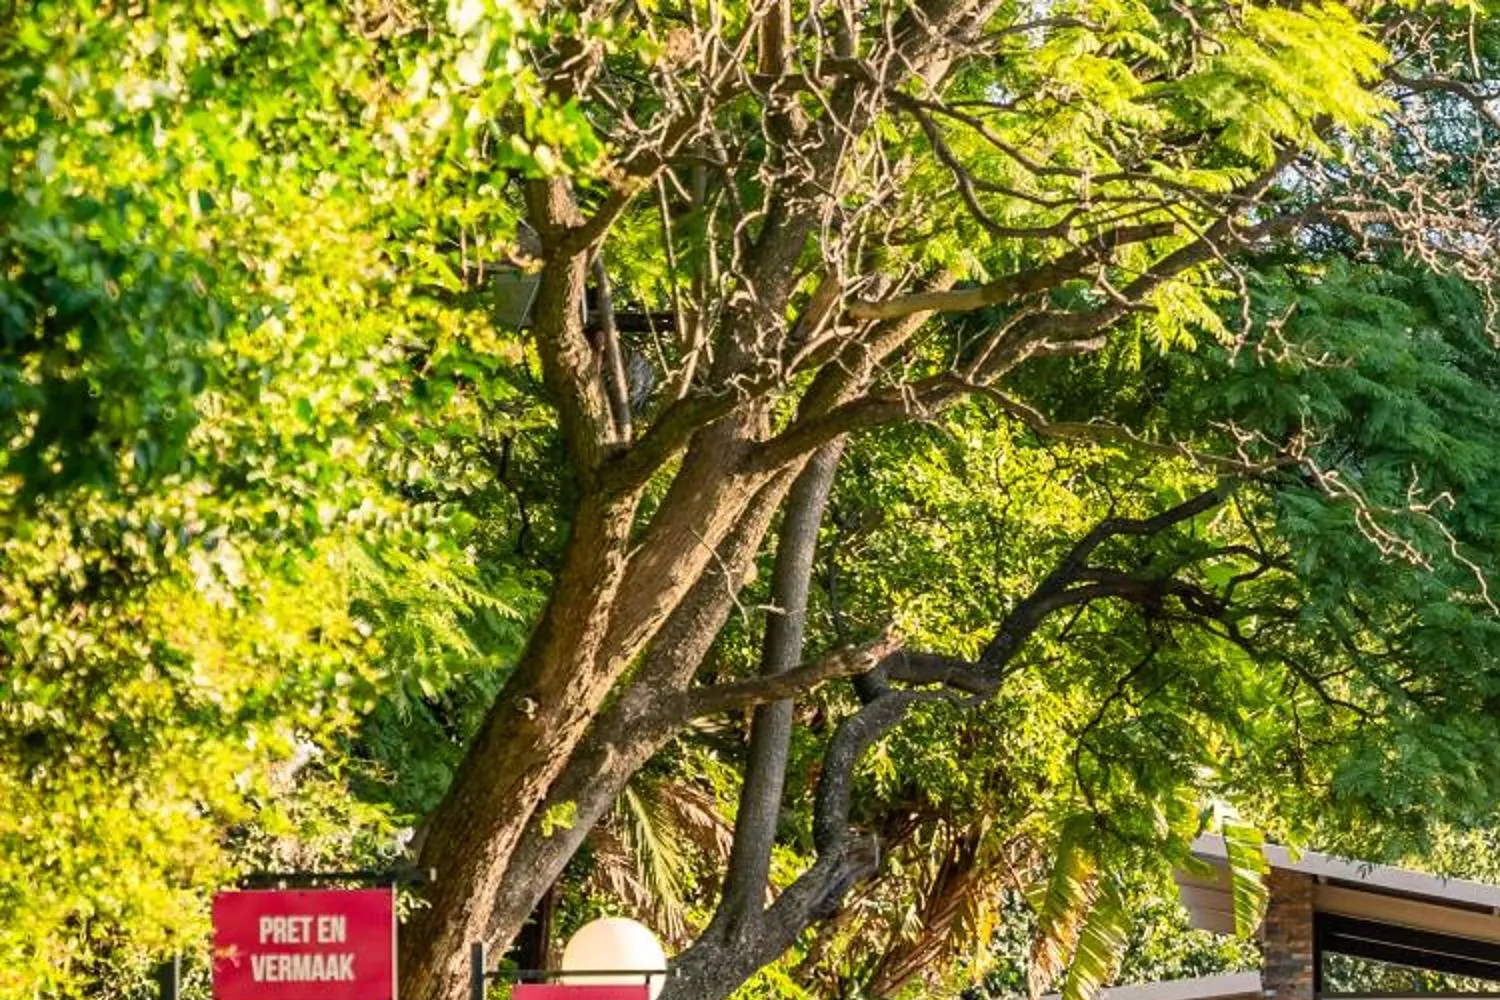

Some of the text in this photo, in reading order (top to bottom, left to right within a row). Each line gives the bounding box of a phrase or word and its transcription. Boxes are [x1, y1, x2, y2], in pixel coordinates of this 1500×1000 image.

[259, 914, 347, 944] PRET EN
[251, 952, 356, 982] VERMAAK
